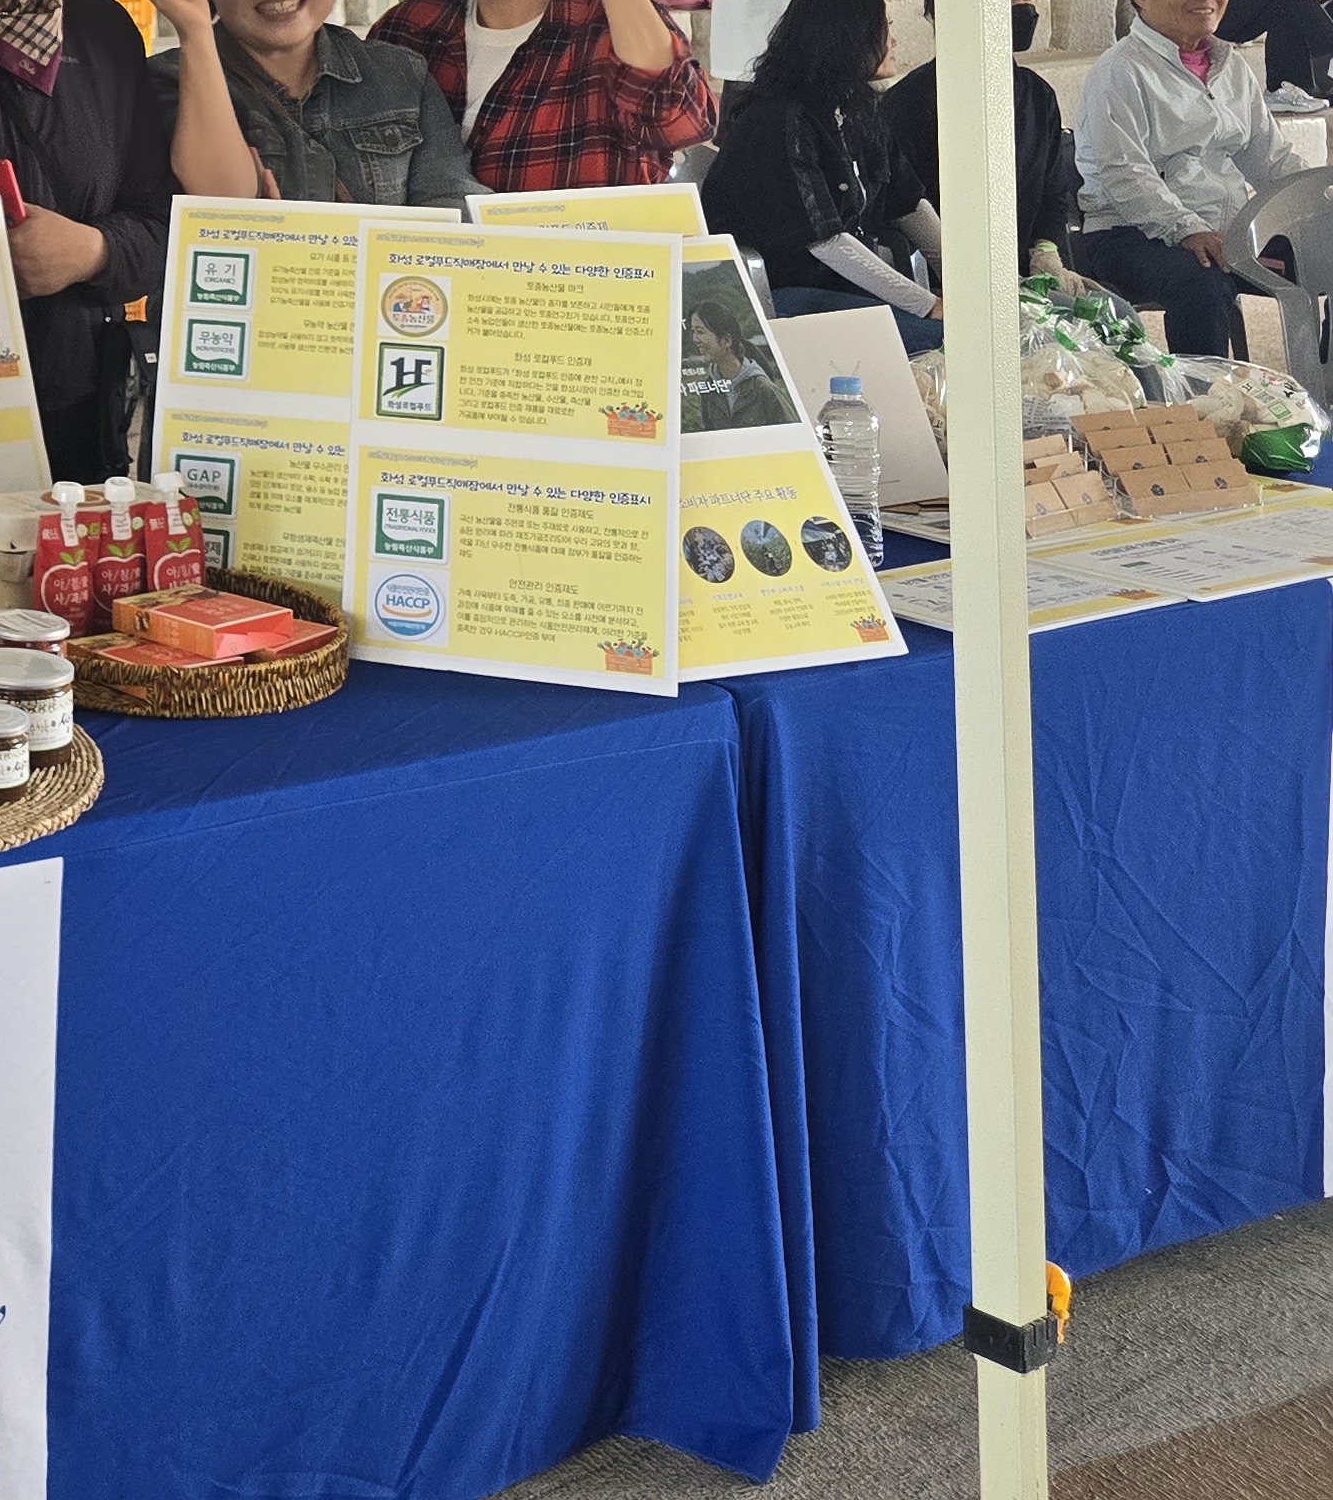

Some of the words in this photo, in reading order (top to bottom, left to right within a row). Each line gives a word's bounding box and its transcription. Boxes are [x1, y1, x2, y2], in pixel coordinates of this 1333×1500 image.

[199, 229, 220, 239] 화성
[223, 230, 306, 242] 로컬푸드직매장에서
[308, 234, 328, 244] 만날
[331, 236, 338, 245] 수
[388, 253, 412, 266] 화성
[415, 255, 509, 270] 로컬푸드직매장에서
[512, 262, 535, 274] 만날
[538, 263, 548, 274] 수
[551, 264, 572, 276] 있는
[575, 265, 610, 278] 다양한
[613, 267, 654, 280] 인증표시
[526, 281, 566, 293] 토종농산물
[568, 283, 584, 294] 마크
[199, 331, 233, 345] 무농약
[514, 353, 531, 363] 화성
[533, 354, 565, 365] 로컬푸드
[567, 356, 592, 367] 인증제
[460, 365, 475, 374] 화성
[387, 400, 432, 412] 화성로컬푸드
[182, 432, 203, 444] 화성
[292, 442, 313, 454] 만날
[317, 445, 324, 454] 수
[187, 468, 221, 483] GAP
[380, 472, 405, 484] 화성
[407, 474, 503, 492] 로컬푸드직매장에서
[506, 484, 530, 496] 만날
[533, 486, 542, 496] 수
[546, 487, 567, 500] 있는
[570, 489, 605, 502] 다양한
[609, 492, 651, 506] 인증표시
[710, 491, 753, 505] 파트너단
[754, 489, 775, 500] 주요
[775, 485, 797, 499] 활동
[385, 507, 435, 524] 전통식품
[507, 503, 540, 515] 전통식품
[542, 505, 559, 516] 품질
[561, 507, 595, 519] 인증제도
[509, 578, 543, 591] 안전관리
[545, 583, 579, 594] 인증제도
[385, 594, 430, 610] HACCP
